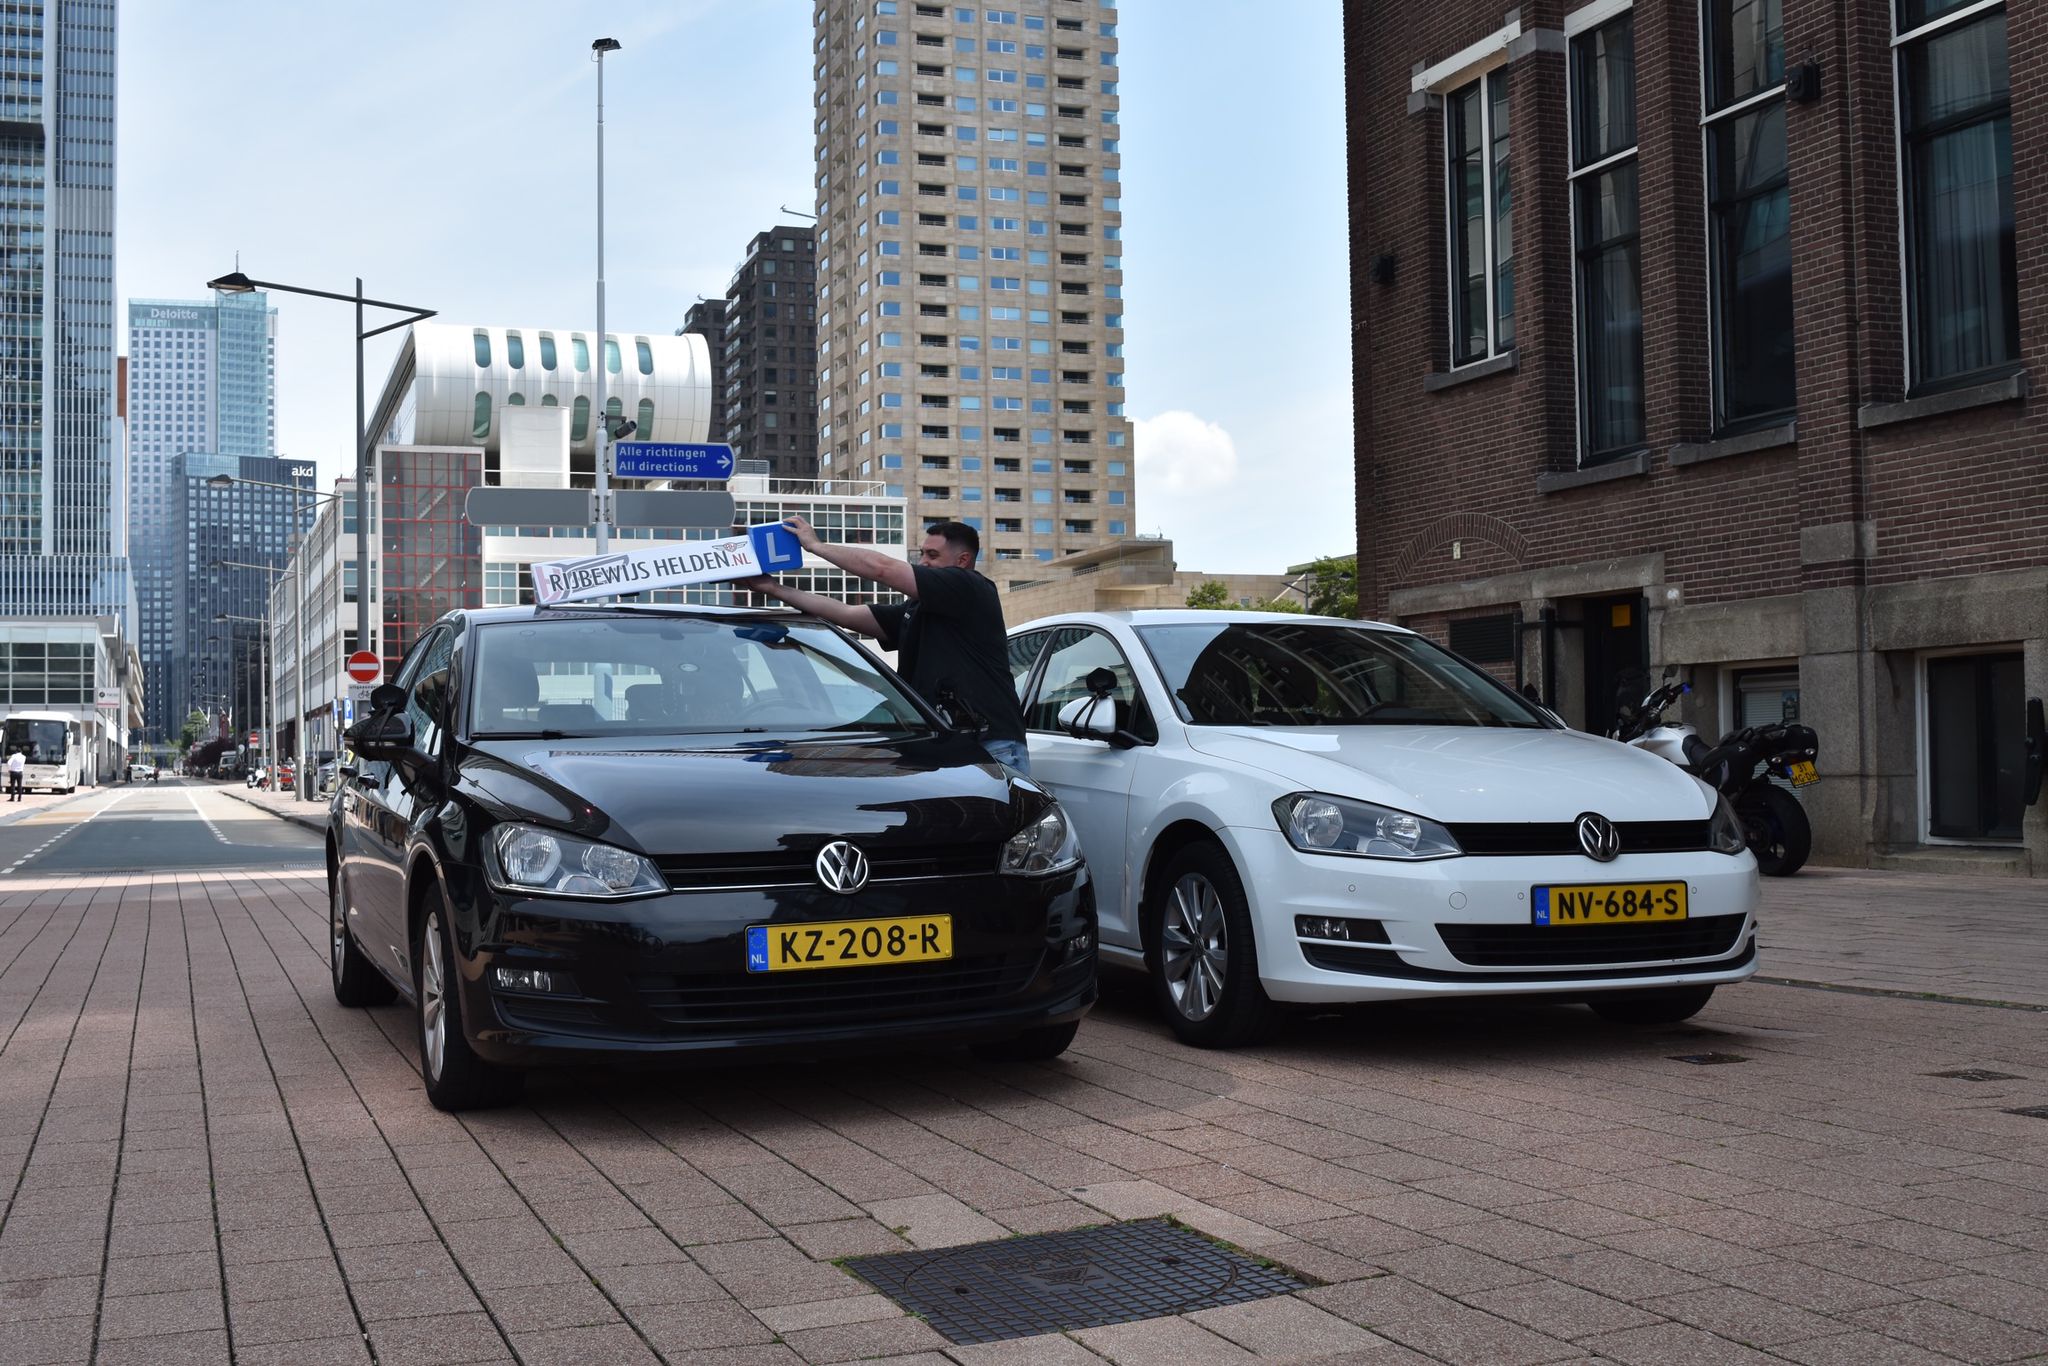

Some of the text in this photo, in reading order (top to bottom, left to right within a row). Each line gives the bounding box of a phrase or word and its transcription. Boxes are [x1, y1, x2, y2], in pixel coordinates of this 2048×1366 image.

[150, 308, 199, 320] Deloitte
[619, 446, 706, 460] Alle richtingen
[291, 465, 314, 477] akd
[619, 461, 698, 473] All directions
[766, 532, 791, 563] L
[549, 561, 651, 592] RIJBEWIJS
[1536, 888, 1679, 920] NL NV-684-S
[751, 923, 941, 964] NL KZ-208-R
